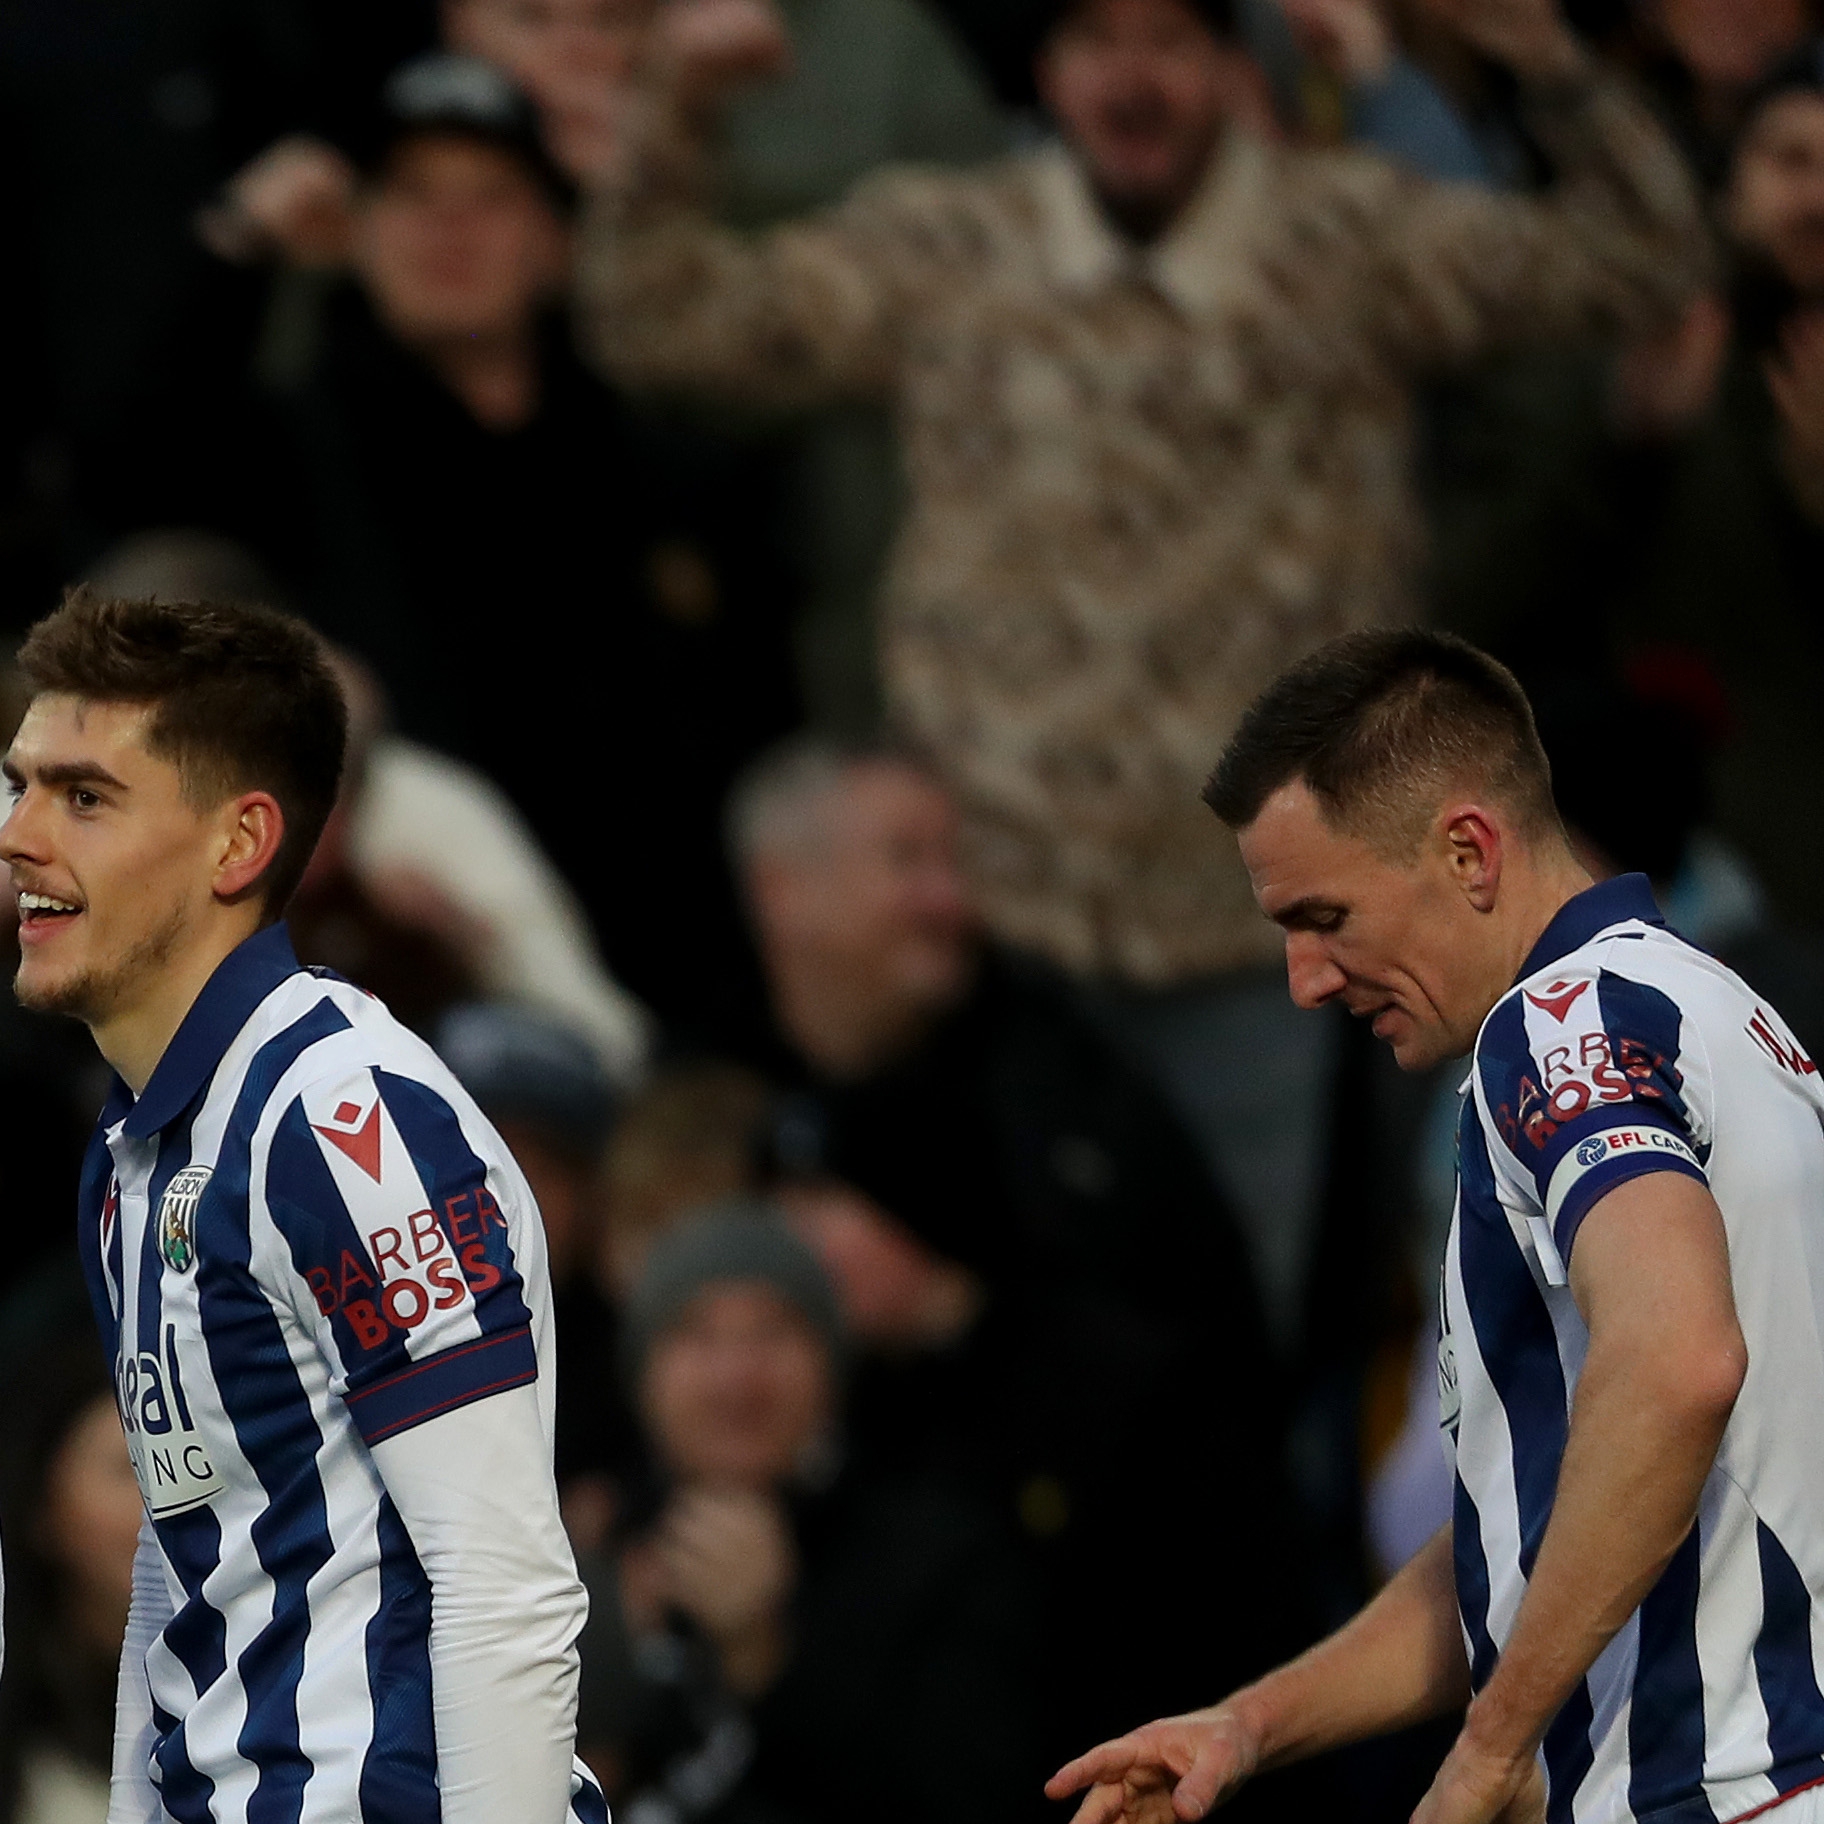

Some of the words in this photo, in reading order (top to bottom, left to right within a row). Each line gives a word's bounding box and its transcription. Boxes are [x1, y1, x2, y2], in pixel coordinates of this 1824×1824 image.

[1607, 1132, 1648, 1149] EFL
[303, 1187, 508, 1317] BARBER
[342, 1242, 502, 1351] BOSS
